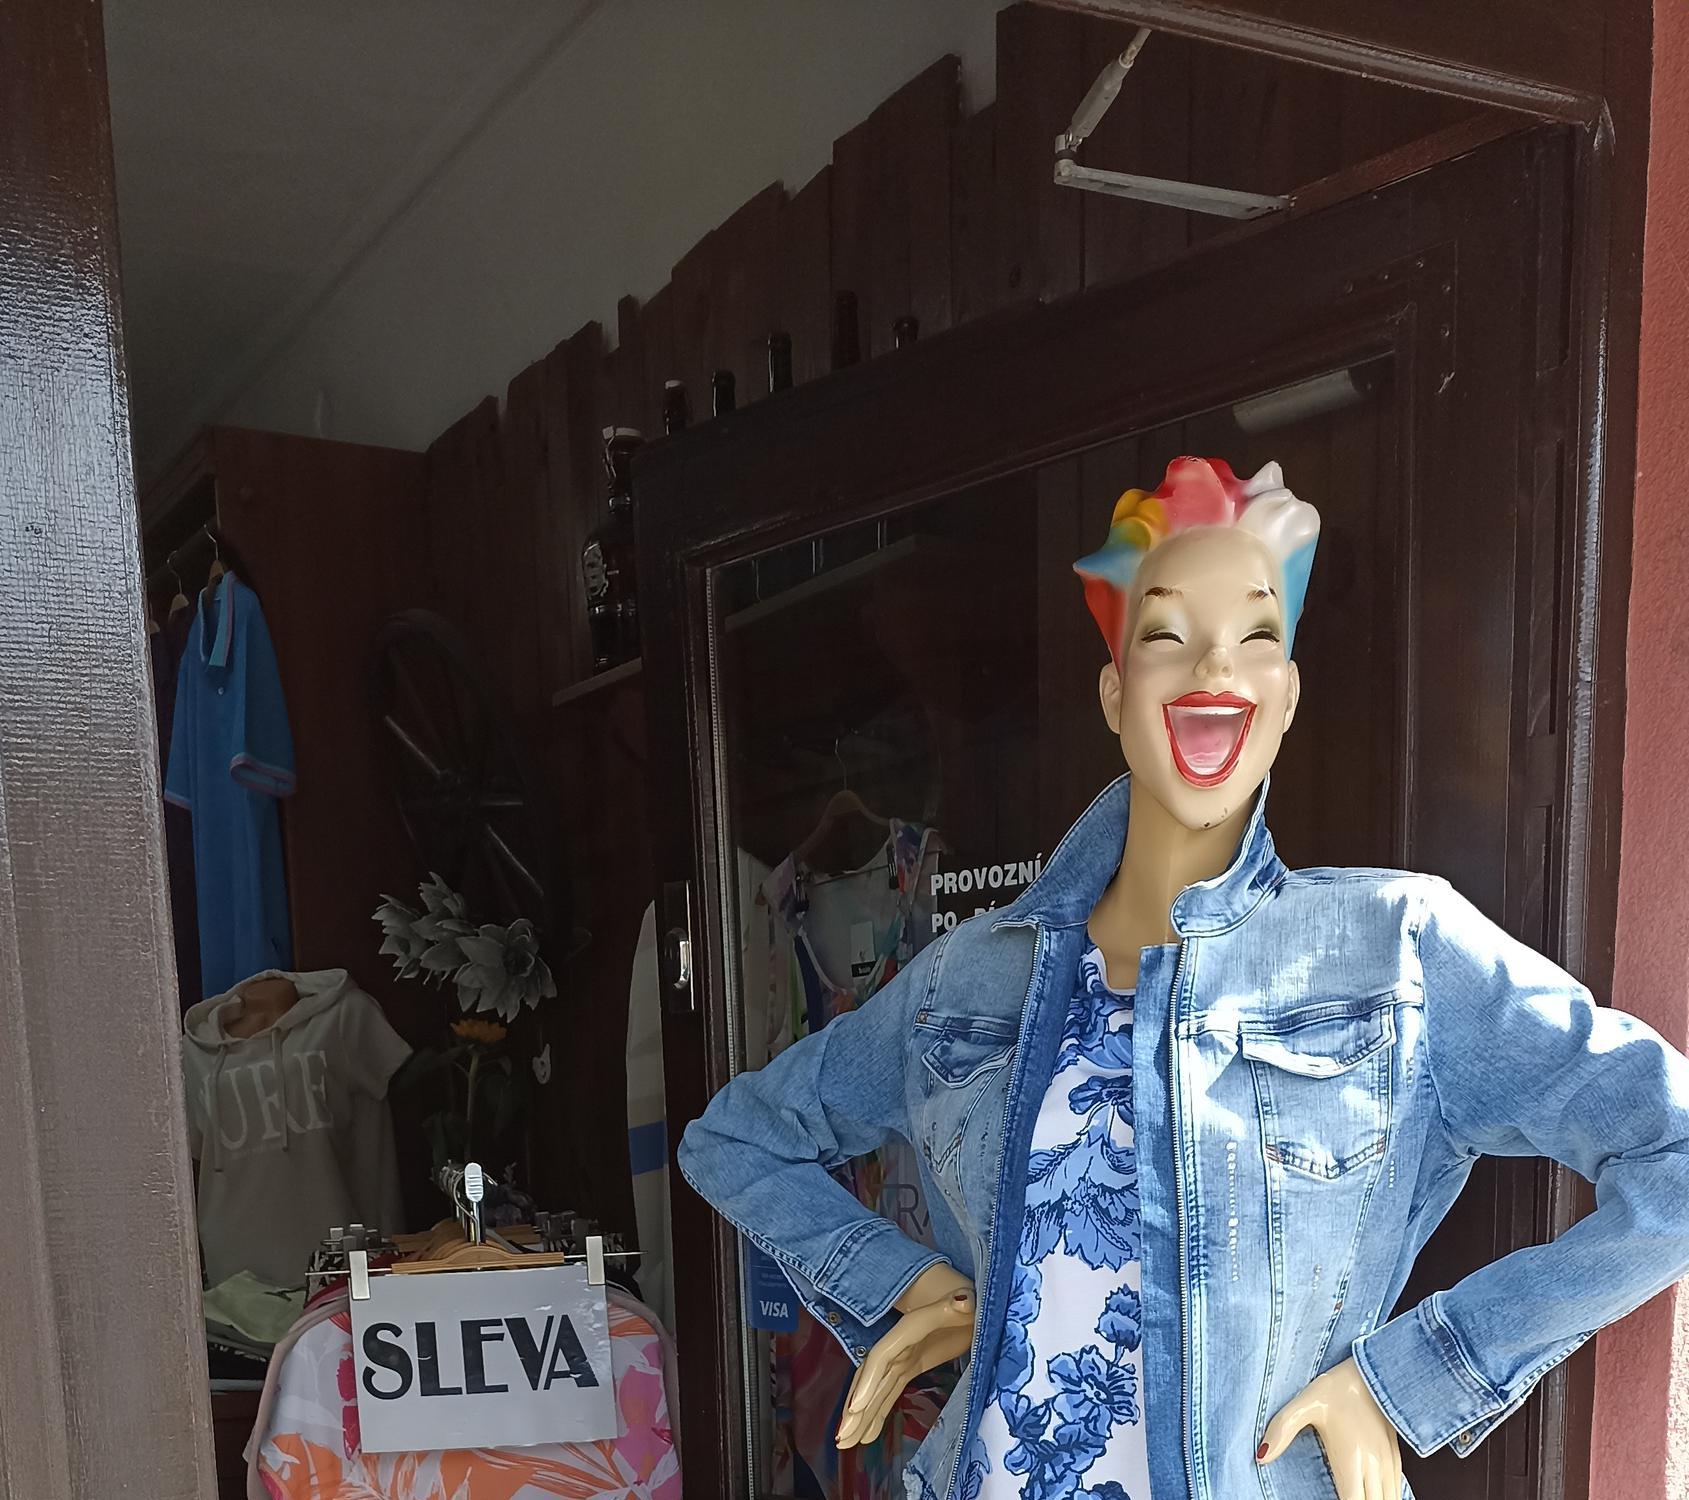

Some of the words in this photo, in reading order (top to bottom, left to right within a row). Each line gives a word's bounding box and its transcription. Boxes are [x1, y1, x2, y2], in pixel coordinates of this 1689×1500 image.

[930, 852, 1043, 896] PROVOZNÍ
[931, 910, 958, 933] PO
[199, 1049, 334, 1150] URE
[759, 1300, 789, 1318] VISA
[362, 1314, 600, 1400] SLEVA
